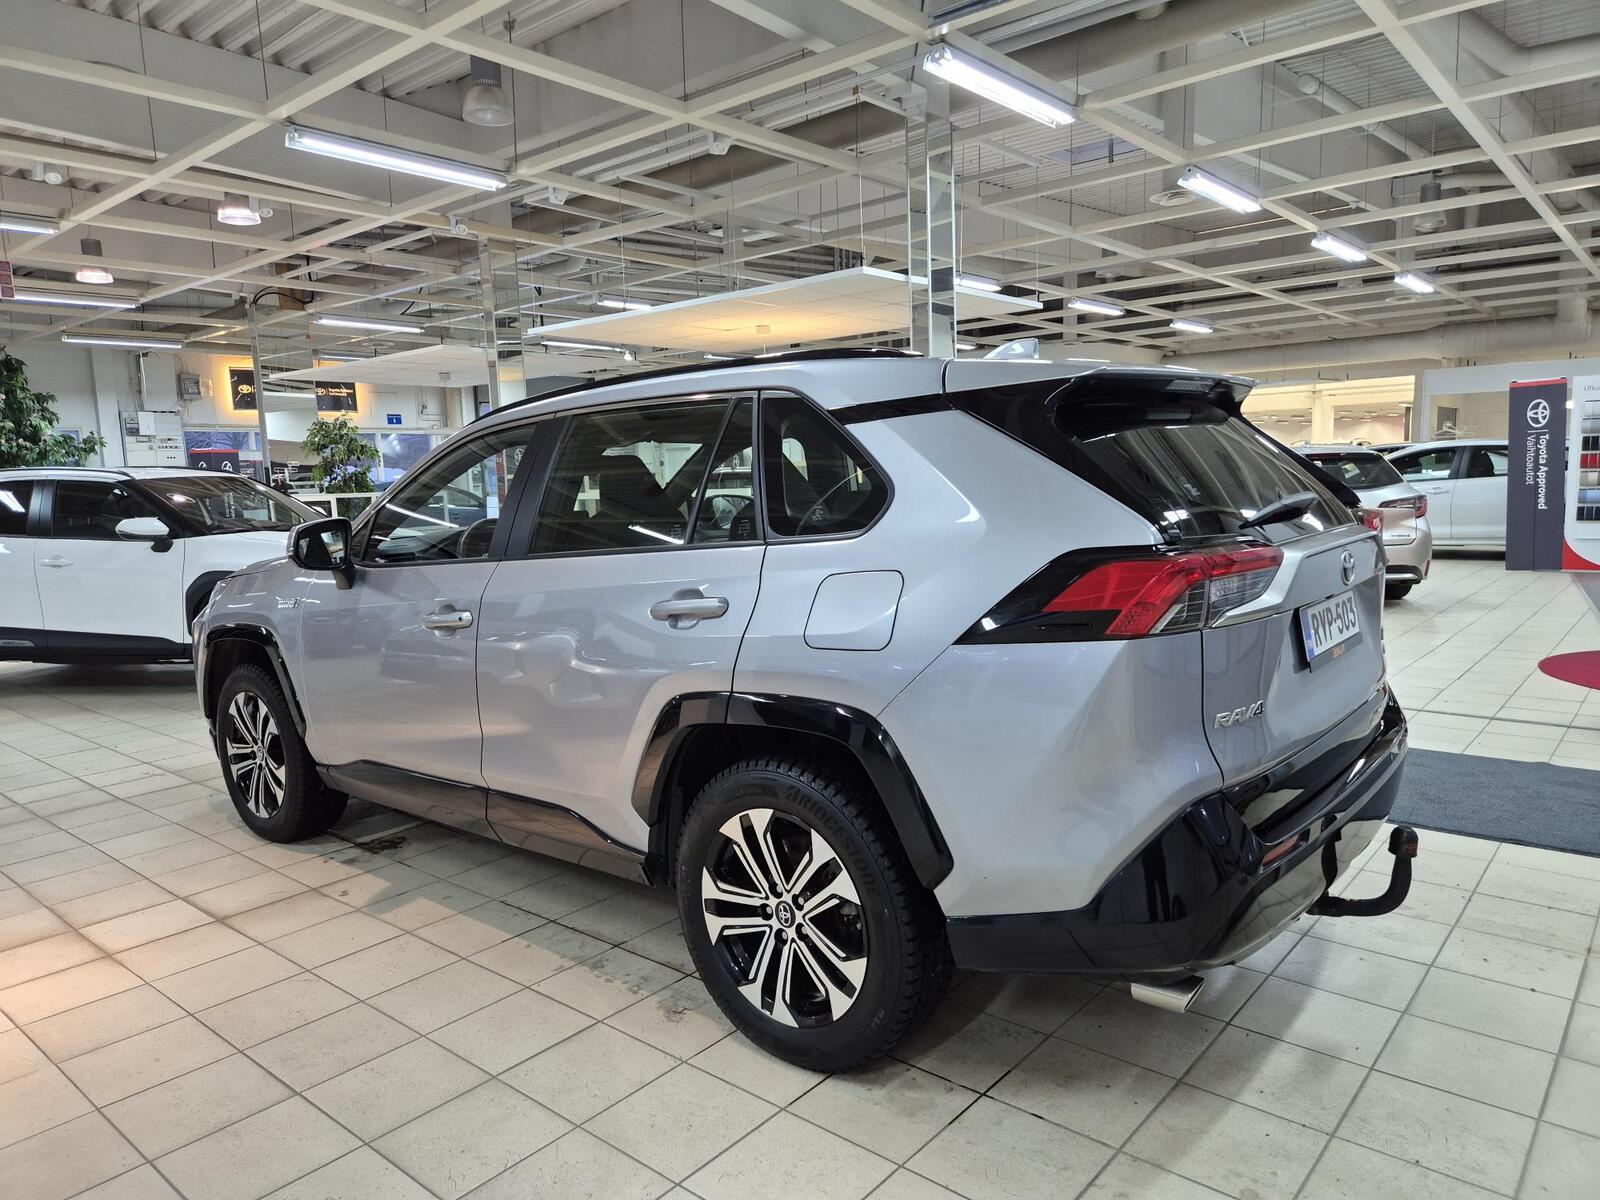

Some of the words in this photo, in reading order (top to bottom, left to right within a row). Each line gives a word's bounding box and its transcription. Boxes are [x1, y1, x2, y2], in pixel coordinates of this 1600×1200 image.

[1526, 434, 1536, 485] Vaihtoautot
[1537, 434, 1549, 464] Toyota
[1536, 465, 1549, 510] Approved
[1310, 596, 1357, 648] RYP-503
[1214, 700, 1264, 730] RAV4
